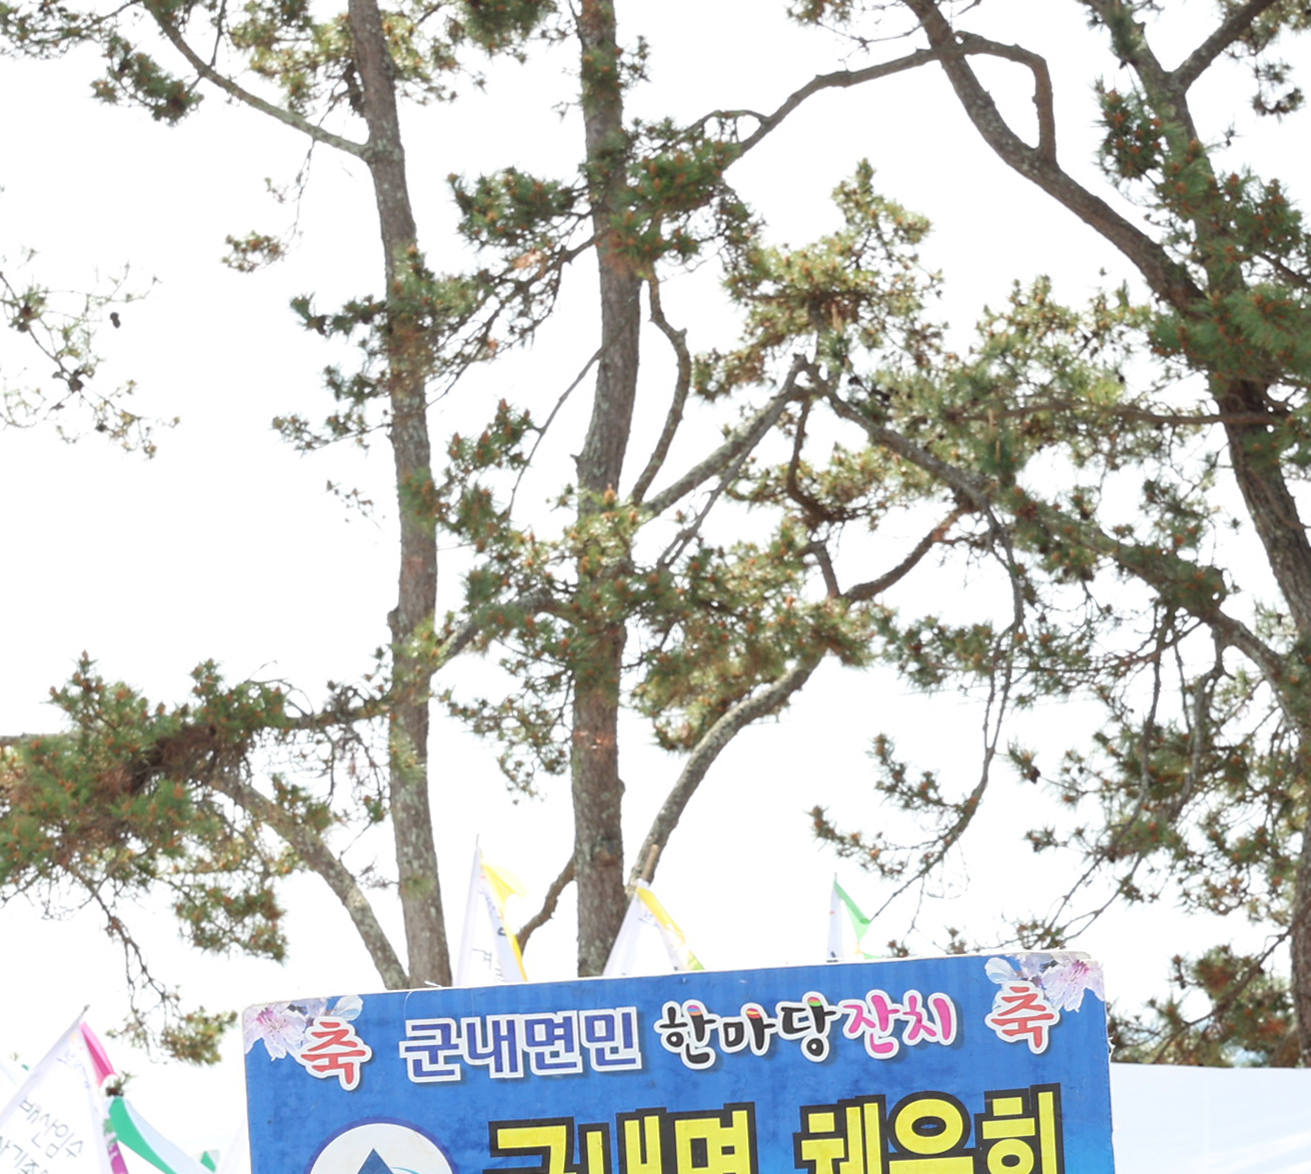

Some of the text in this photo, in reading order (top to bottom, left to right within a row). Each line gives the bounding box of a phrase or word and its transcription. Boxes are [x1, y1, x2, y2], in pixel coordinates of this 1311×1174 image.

[300, 1014, 372, 1091] 축
[400, 1006, 642, 1083] 군내면민
[987, 980, 1060, 1055] 축
